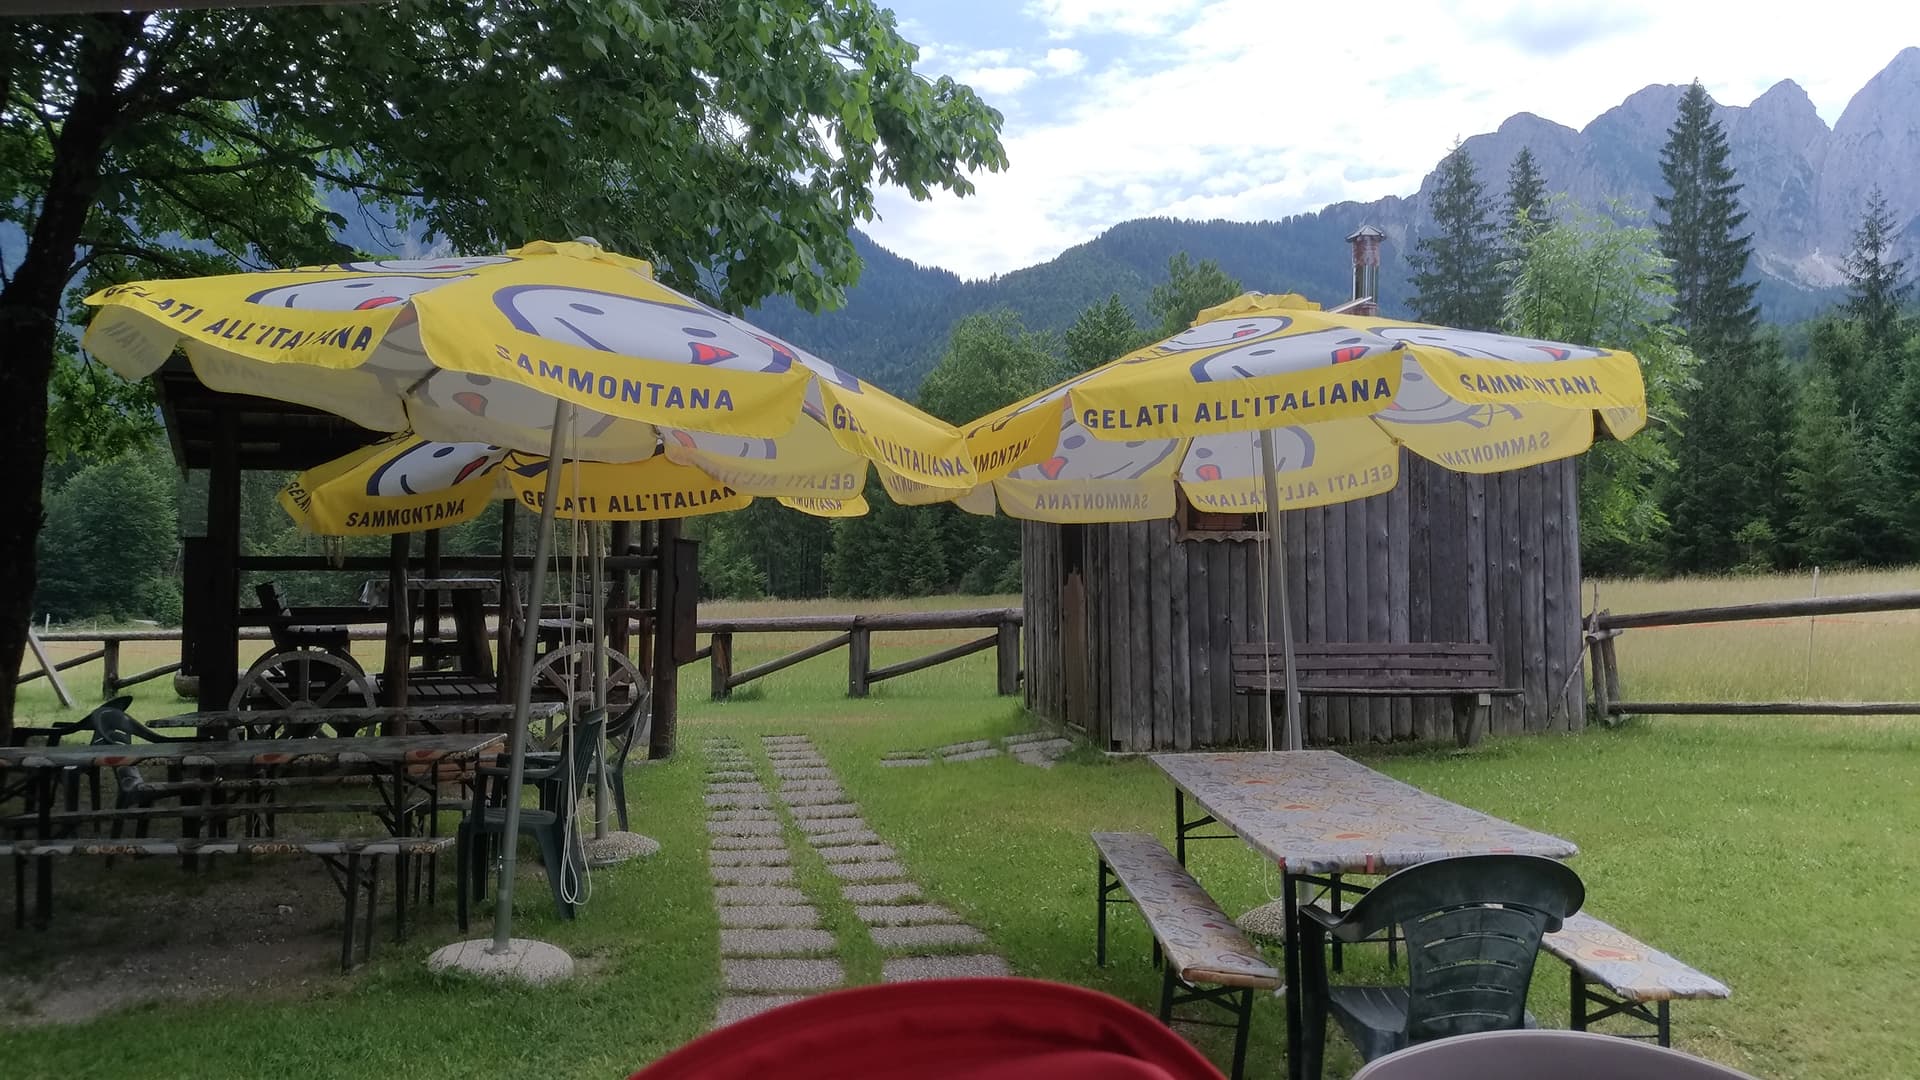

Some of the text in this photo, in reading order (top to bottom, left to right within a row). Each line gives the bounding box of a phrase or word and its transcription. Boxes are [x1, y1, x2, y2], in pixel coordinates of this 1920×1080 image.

[495, 344, 734, 411] SAMMONTANA
[1460, 373, 1602, 395] SAMMONTANA
[1083, 377, 1391, 429] GELATI ALL'ITALIANA
[346, 499, 465, 528] SAMMONTANA
